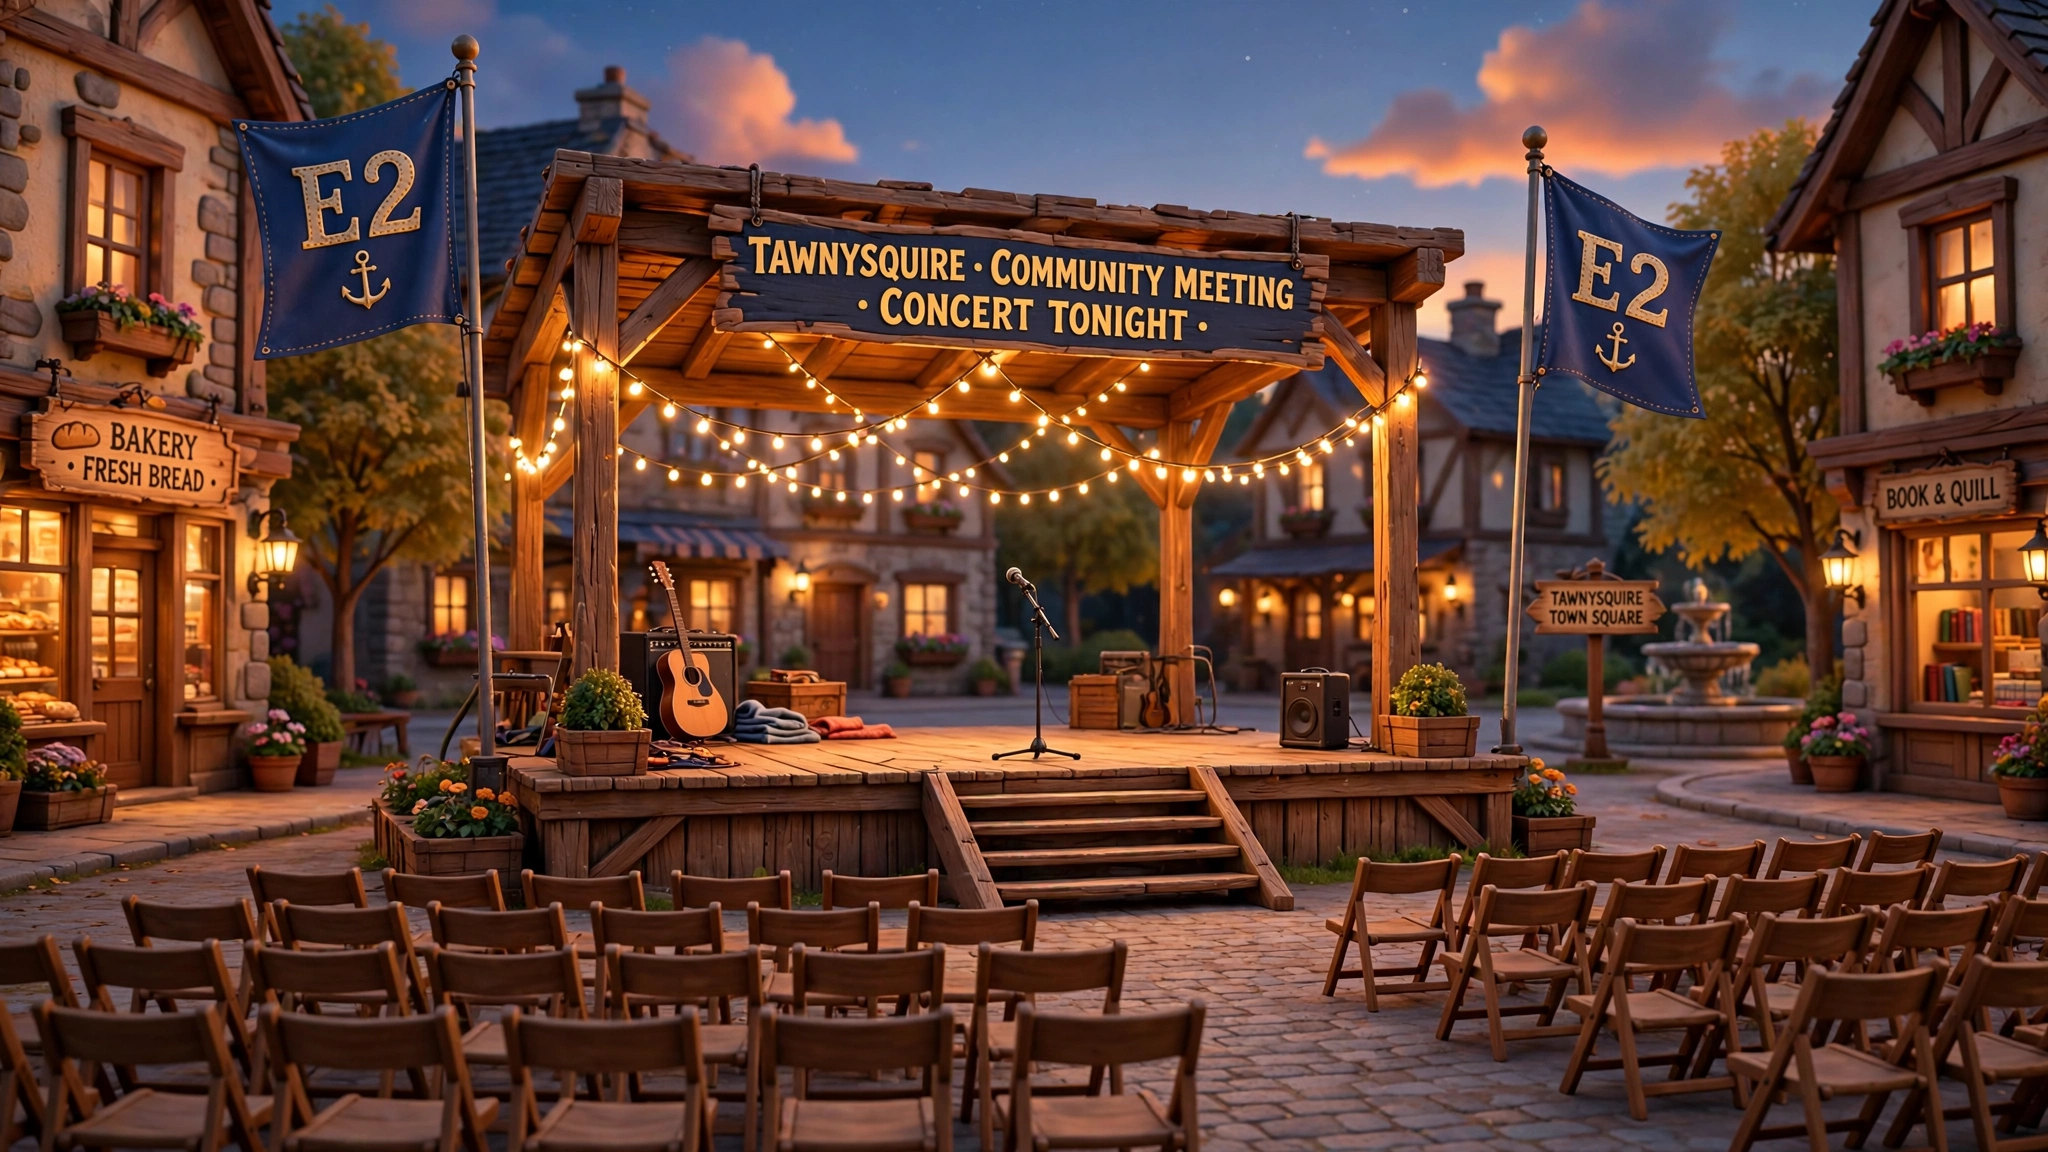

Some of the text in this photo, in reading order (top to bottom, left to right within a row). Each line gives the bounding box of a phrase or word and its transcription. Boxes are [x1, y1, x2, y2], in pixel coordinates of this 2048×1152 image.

[291, 150, 421, 250] E2
[748, 236, 1294, 310] TAWNYSQUIRE COMMUNITY MEETING
[1572, 229, 1669, 328] E2
[879, 287, 1188, 341] CONCERT TONIGHT
[110, 422, 198, 461] BAKERY
[83, 455, 204, 492] FRESH BREAD
[1886, 476, 2000, 509] BOOK & QUILL
[1549, 609, 1643, 627] TOWN SQUARE
[1550, 590, 1643, 607] TAWNYSQUIRE
